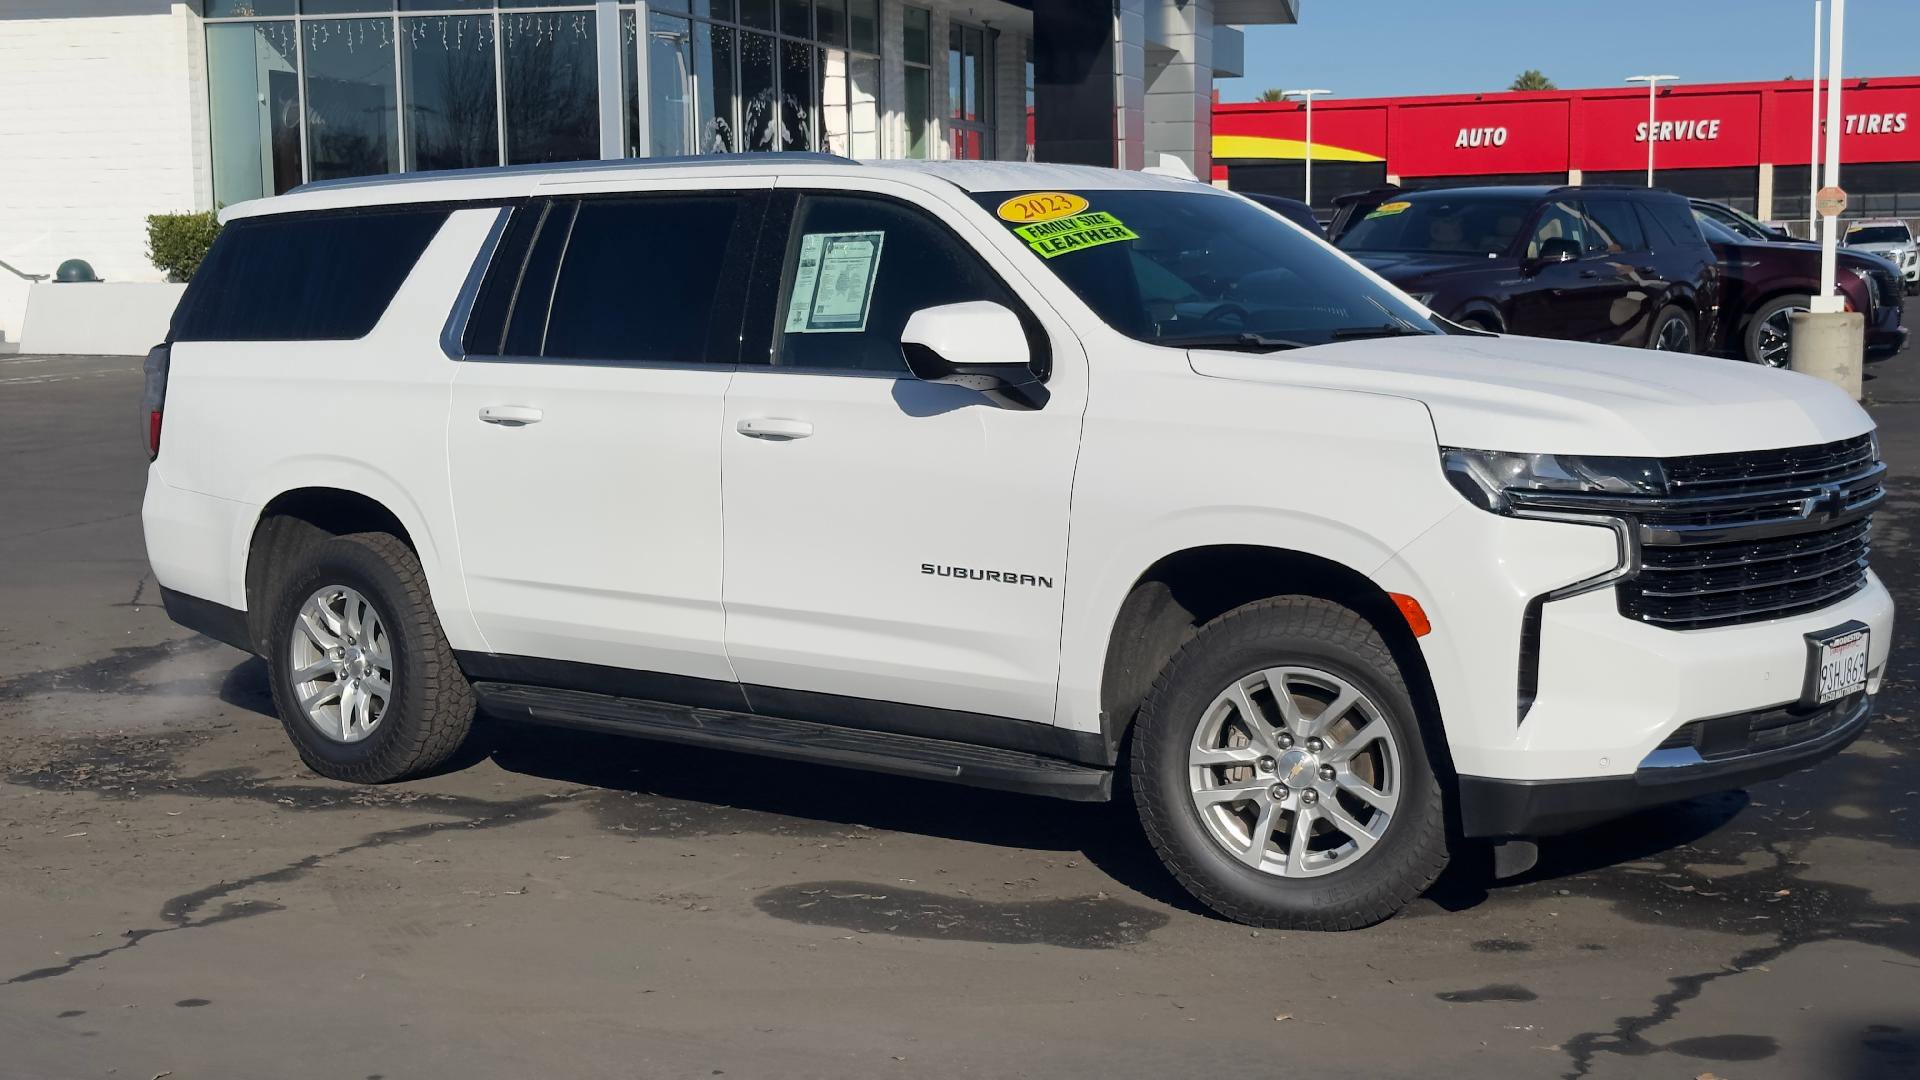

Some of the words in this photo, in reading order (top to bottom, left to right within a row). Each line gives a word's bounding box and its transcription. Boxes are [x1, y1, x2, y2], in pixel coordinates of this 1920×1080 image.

[1454, 127, 1507, 148] AUTO
[1635, 119, 1720, 142] SERVICE
[1845, 112, 1907, 135] TIRES
[1015, 195, 1072, 219] 2023
[1026, 215, 1078, 238] FAMILY
[1078, 213, 1110, 228] SIZE
[1038, 226, 1128, 254] LEATHER
[921, 562, 1053, 588] SUBURBAN
[1820, 652, 1865, 695] 9SHJ869
